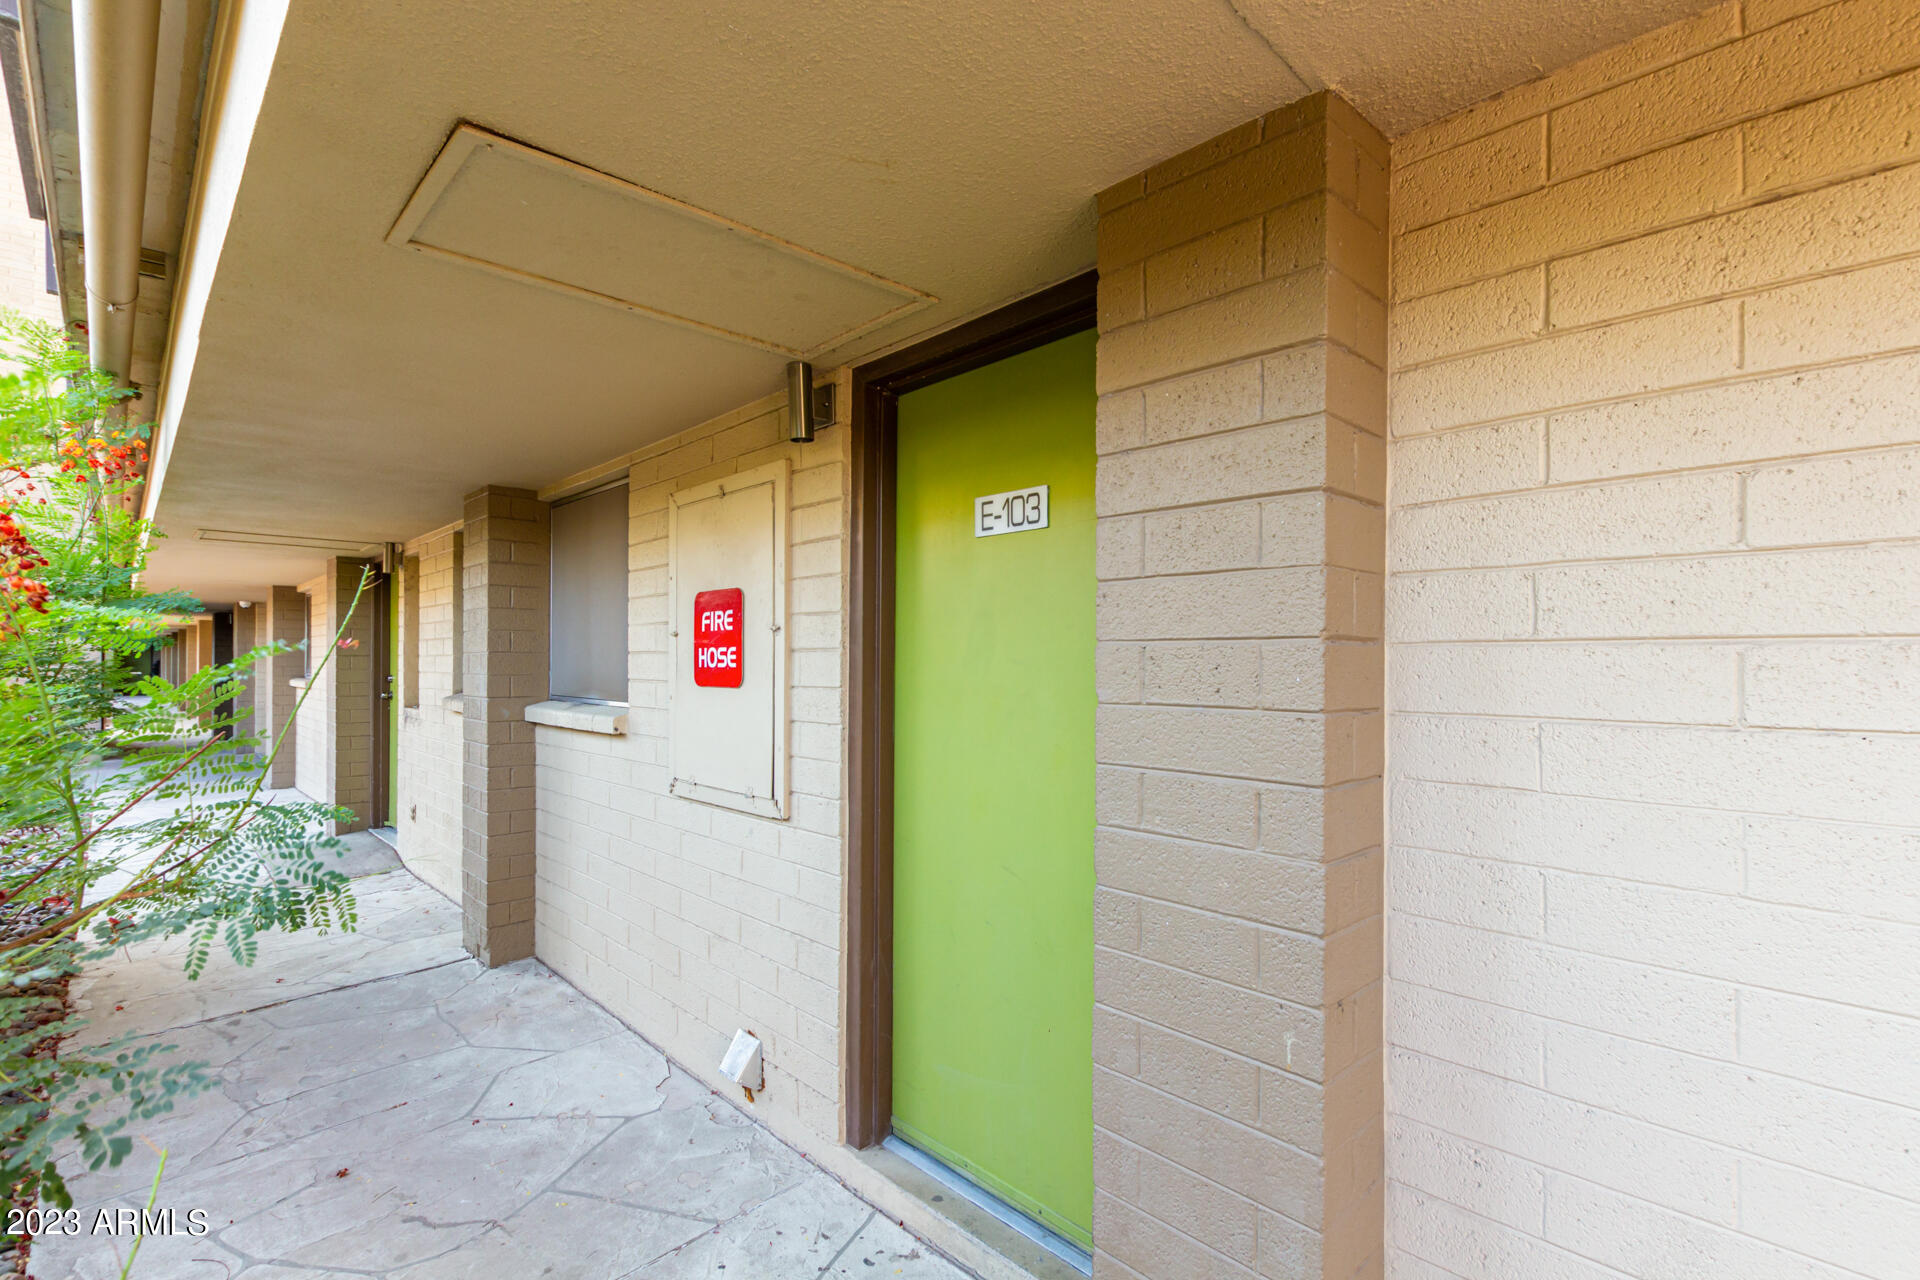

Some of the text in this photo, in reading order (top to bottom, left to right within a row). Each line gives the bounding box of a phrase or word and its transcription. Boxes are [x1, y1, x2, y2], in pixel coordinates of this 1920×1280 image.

[981, 492, 1041, 531] E-103
[701, 609, 734, 632] FIRE
[698, 646, 737, 668] HOSE
